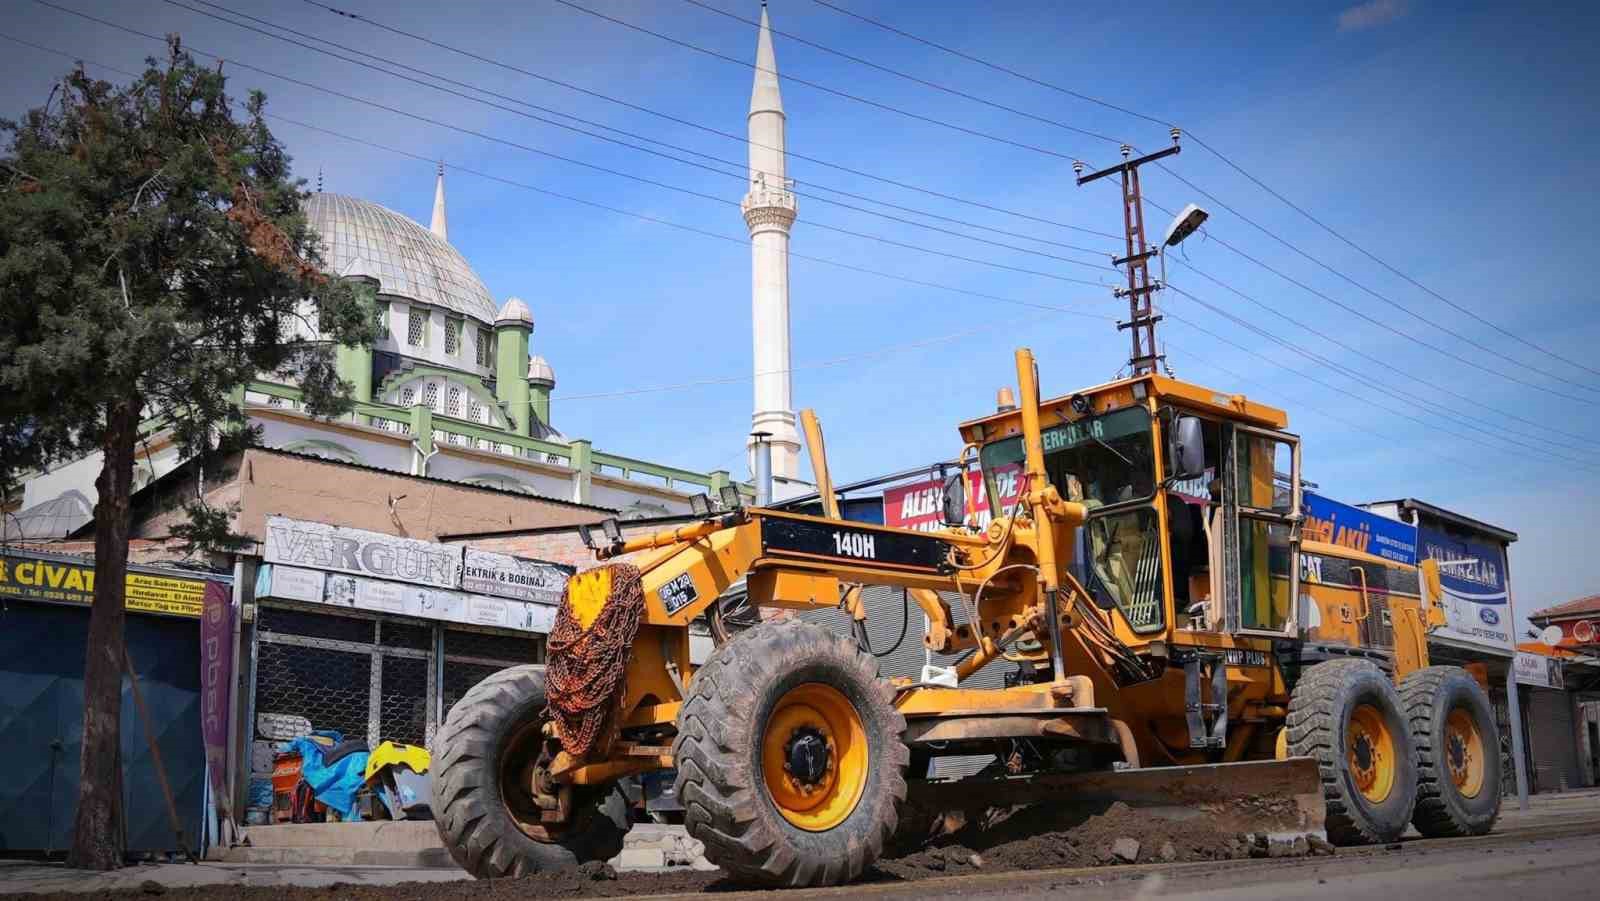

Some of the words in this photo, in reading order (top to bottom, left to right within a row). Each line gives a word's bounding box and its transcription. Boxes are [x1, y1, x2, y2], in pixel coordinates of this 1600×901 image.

[832, 531, 876, 559] 140H
[499, 571, 506, 582] &
[1300, 553, 1322, 584] CAT
